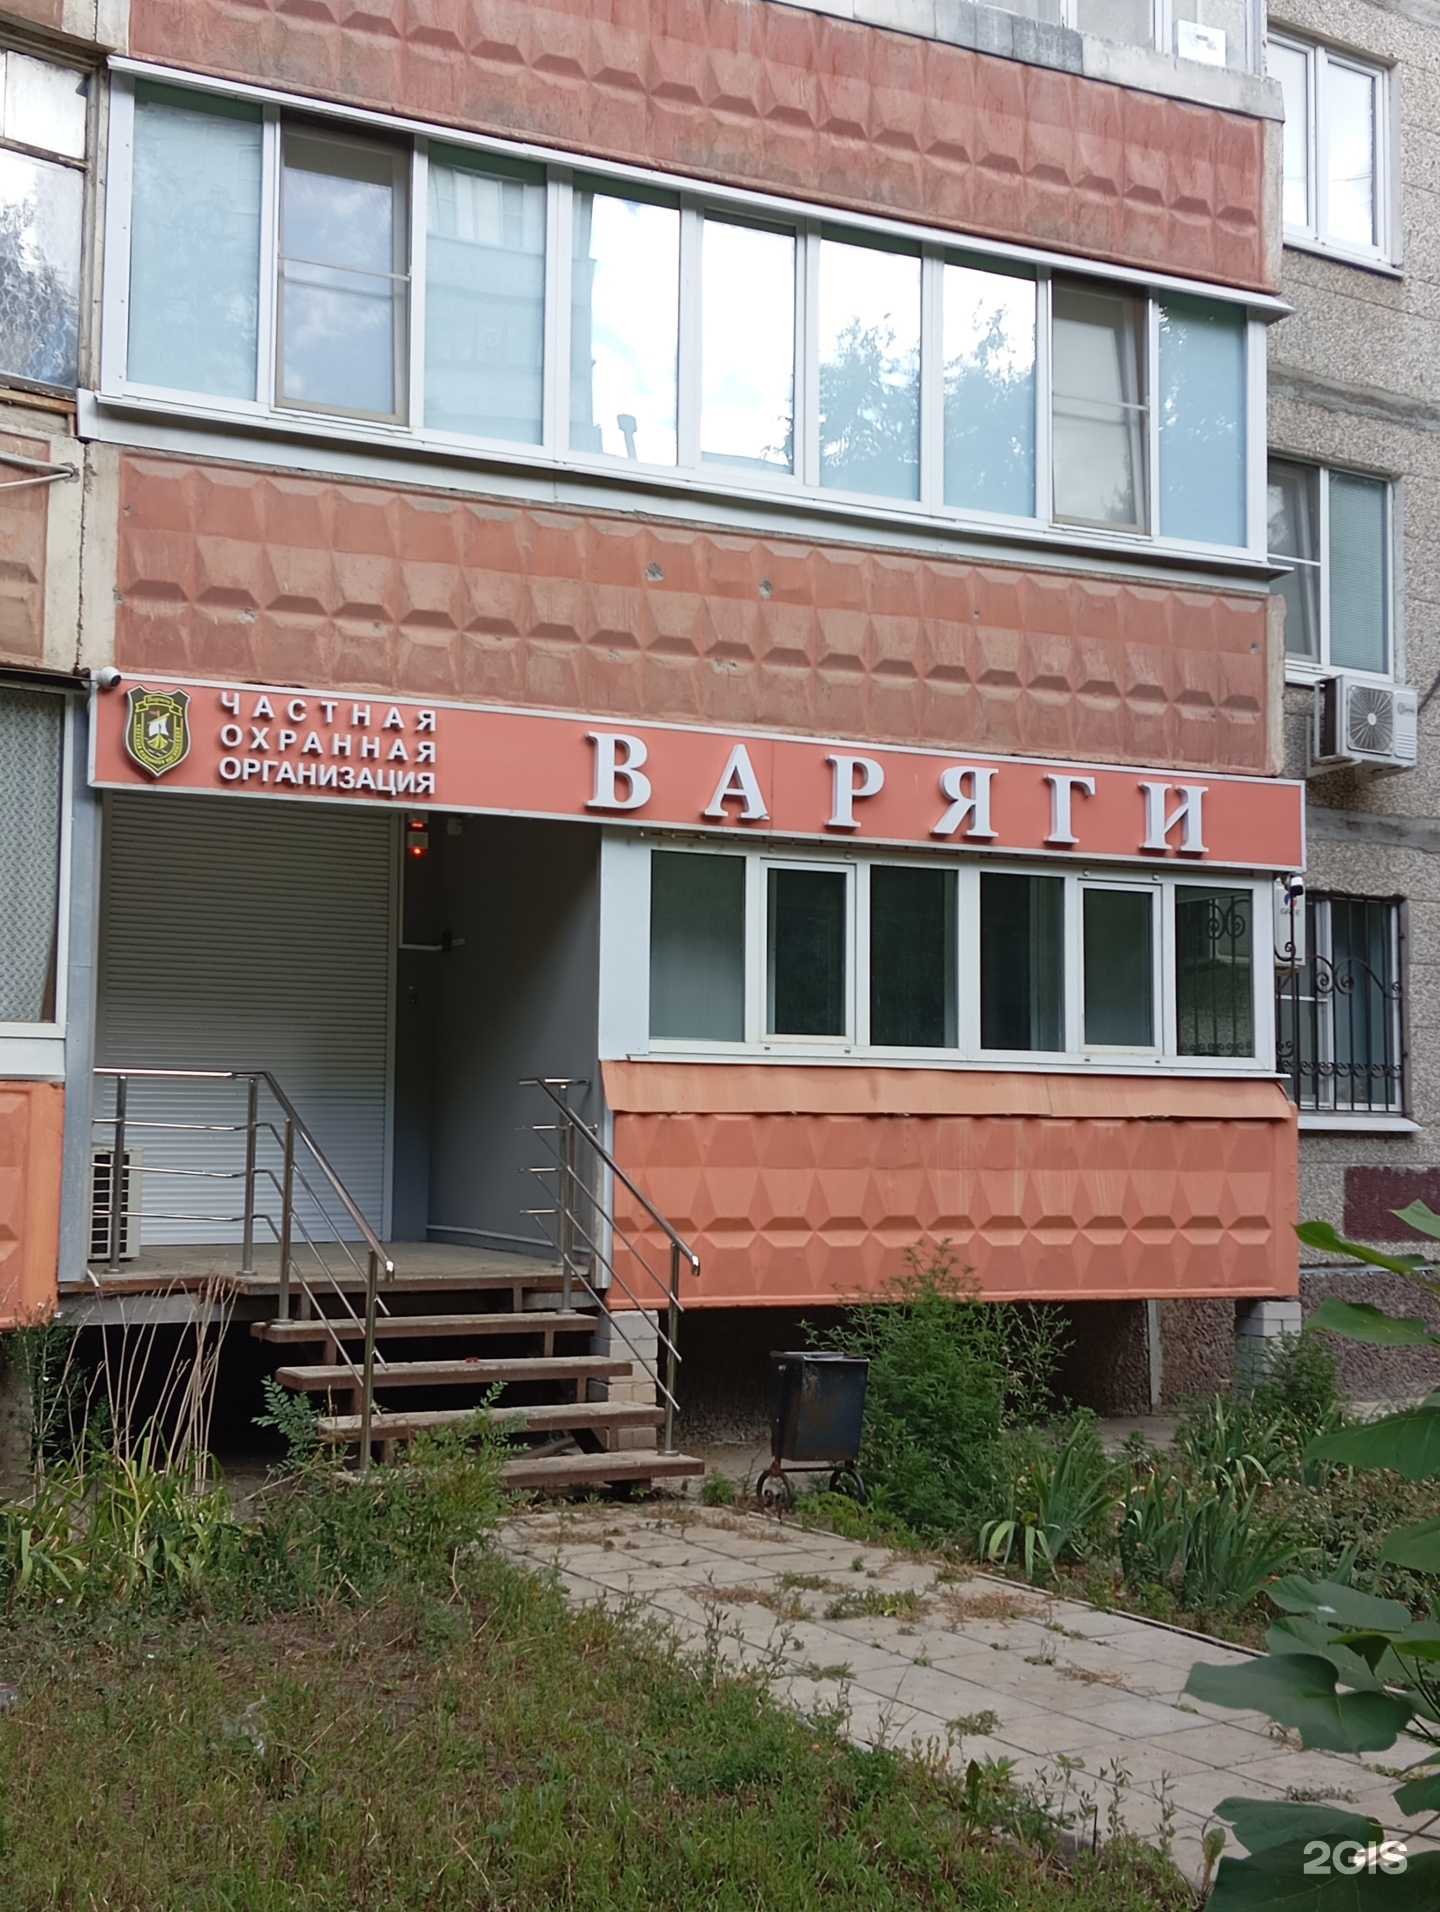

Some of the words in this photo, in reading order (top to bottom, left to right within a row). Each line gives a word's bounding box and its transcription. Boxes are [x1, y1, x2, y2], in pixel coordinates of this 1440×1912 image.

[218, 691, 437, 732] ЧАСТНАЯ
[218, 724, 437, 763] ОХРАННАЯ
[218, 756, 437, 796] ОРГАНИЗАЦИЯ
[585, 731, 1209, 854] ВАРЯГИ
